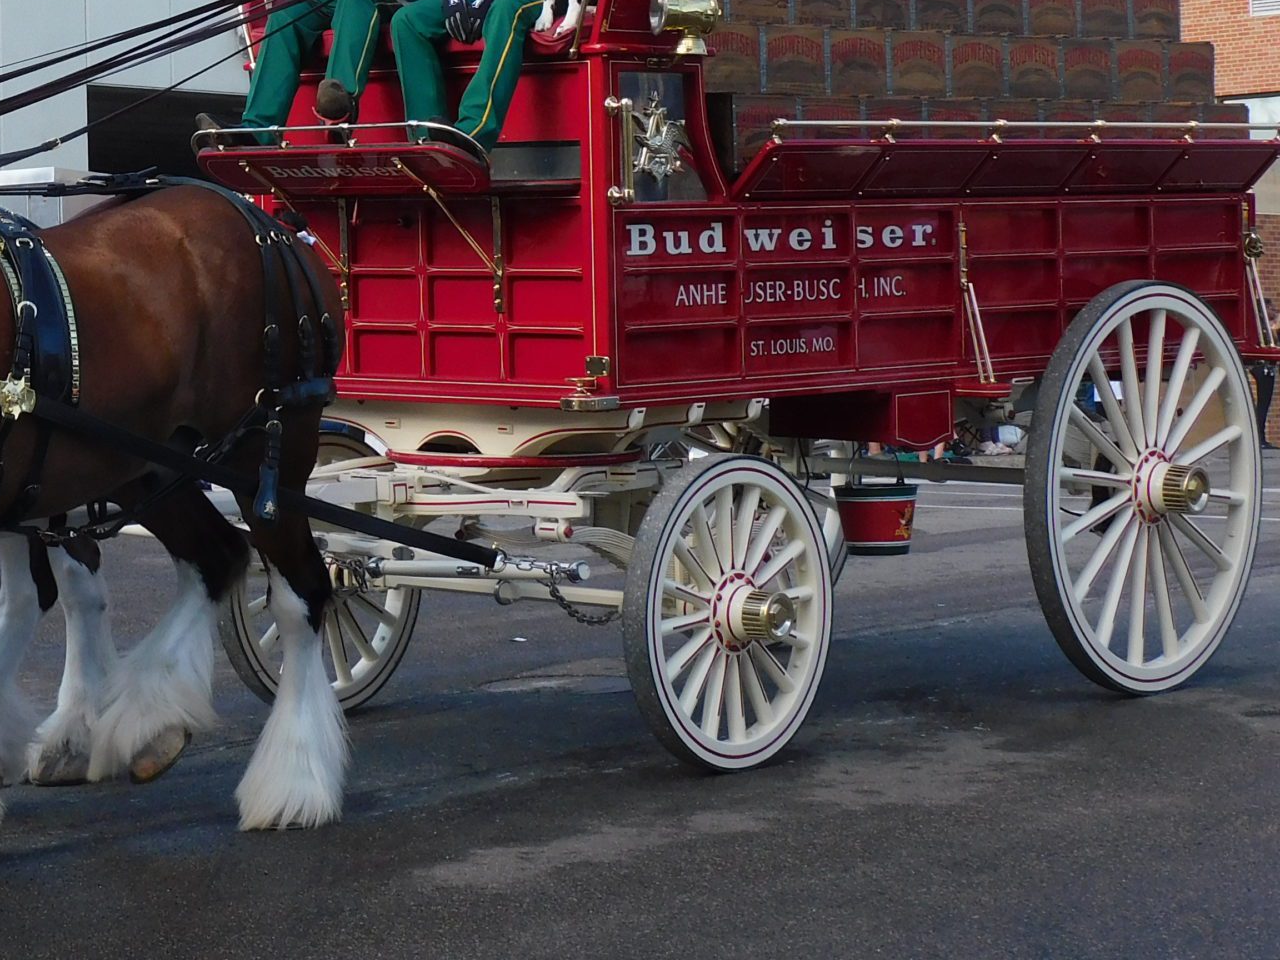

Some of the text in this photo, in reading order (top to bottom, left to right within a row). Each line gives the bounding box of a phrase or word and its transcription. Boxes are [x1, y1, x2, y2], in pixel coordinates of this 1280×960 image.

[263, 164, 403, 179] Budweiser
[874, 276, 907, 297] INC.
[750, 336, 836, 356] ST. LOUIS, MO.
